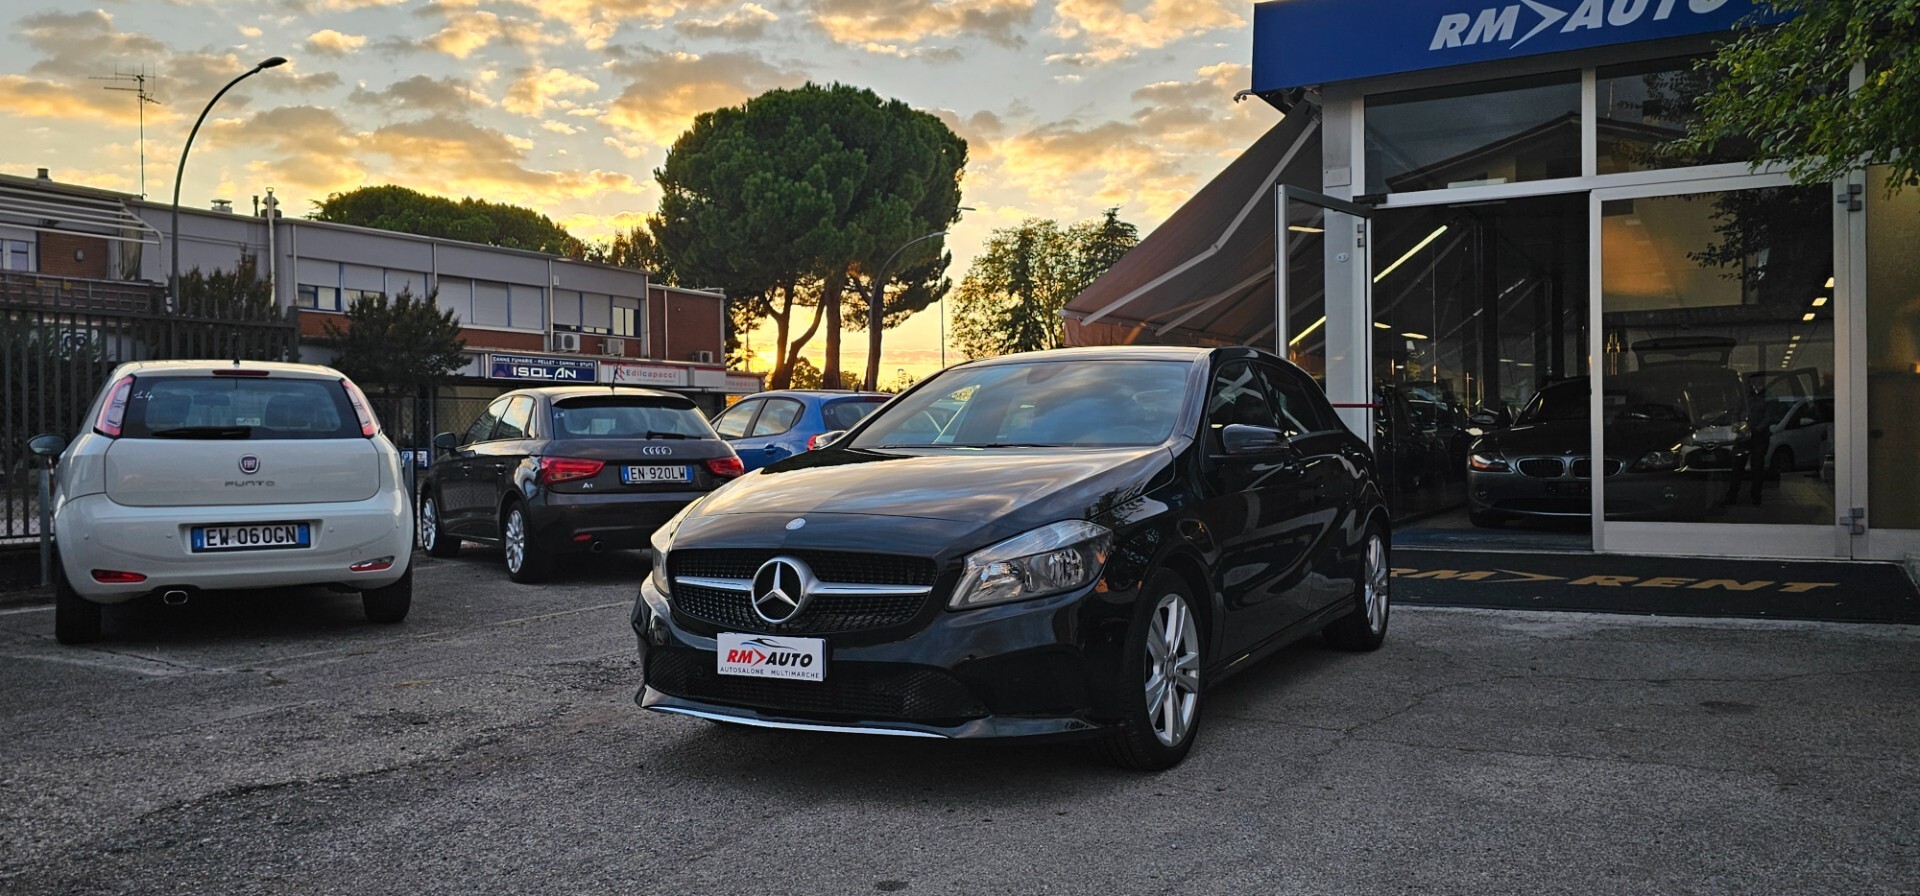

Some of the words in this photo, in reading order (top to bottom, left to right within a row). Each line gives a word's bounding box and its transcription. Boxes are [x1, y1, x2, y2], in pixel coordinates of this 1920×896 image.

[513, 366, 577, 381] ISOLAN
[626, 369, 675, 379] Edilcapacci
[1566, 575, 1841, 593] RENT
[765, 652, 813, 667] AUTO
[719, 666, 765, 675] AUTOSALONE
[770, 669, 820, 679] MULTIMARCHE
